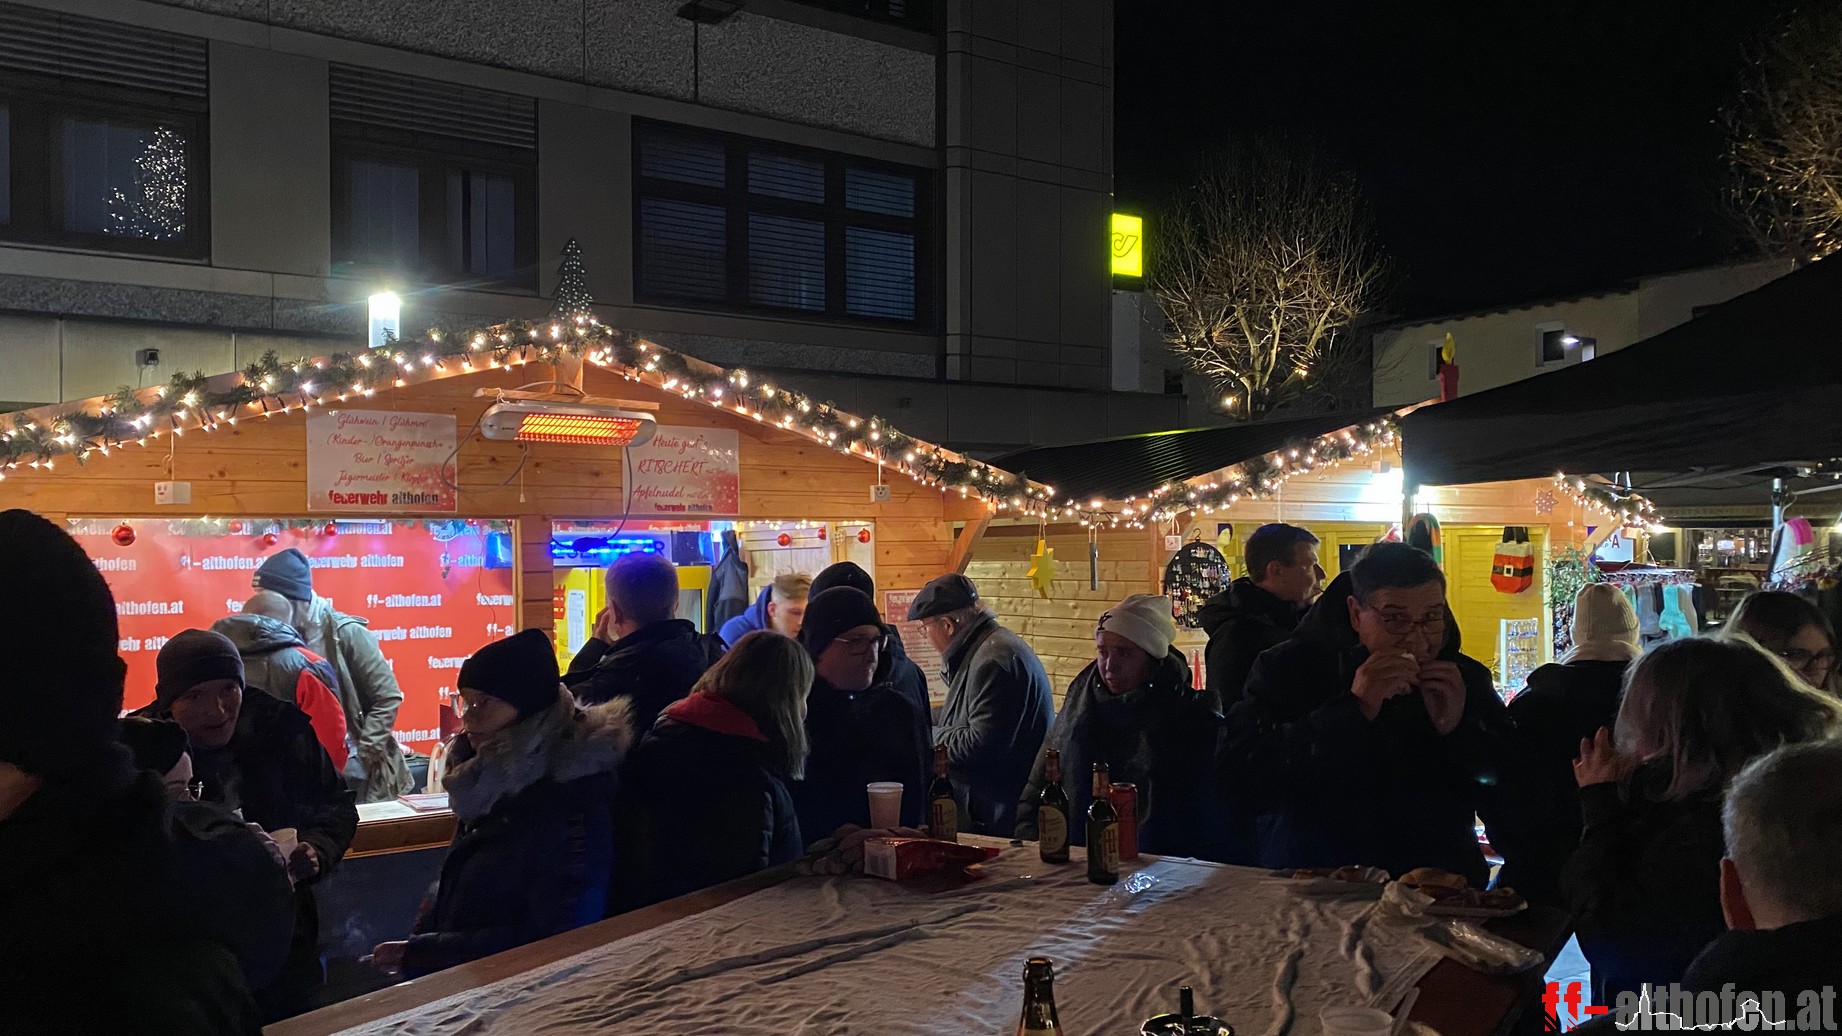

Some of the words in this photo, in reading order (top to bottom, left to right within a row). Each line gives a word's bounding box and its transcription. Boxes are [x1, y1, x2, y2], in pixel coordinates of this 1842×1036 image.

[652, 434, 679, 448] Heute
[353, 452, 374, 464] Bier
[637, 458, 708, 477] RITSCHERT
[328, 489, 389, 505] feuerwehr
[391, 491, 439, 505] althofen
[632, 484, 685, 502] Apfelnudel
[306, 554, 358, 569] euerwehr
[361, 554, 404, 567] althofen
[366, 593, 442, 608] ff-althofen.at
[409, 625, 452, 639] althofen
